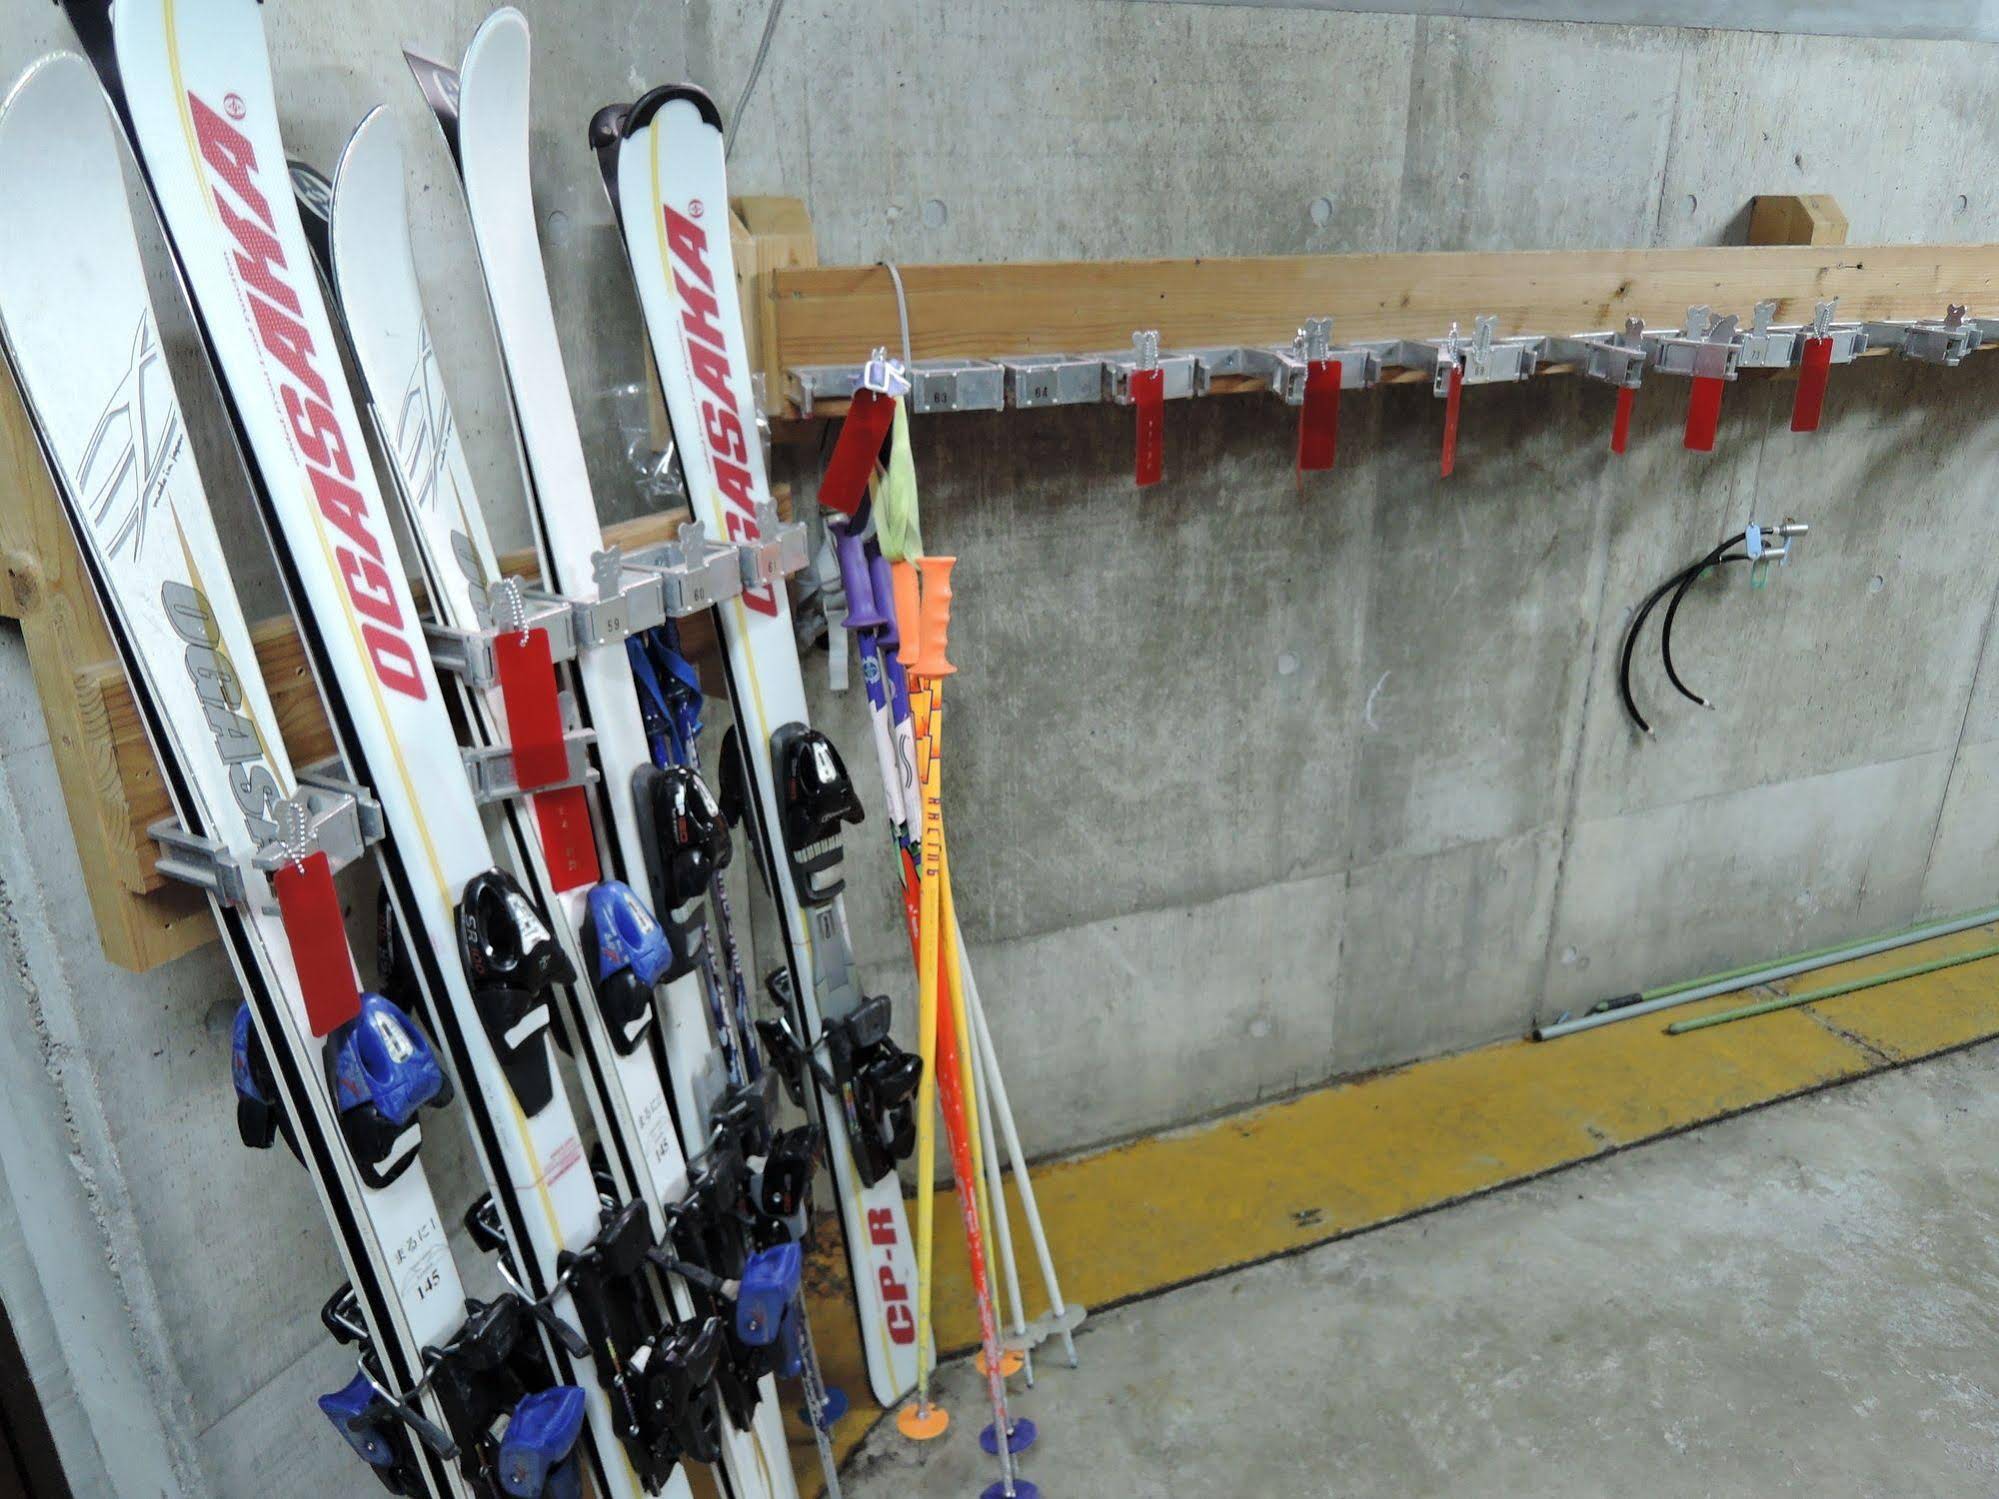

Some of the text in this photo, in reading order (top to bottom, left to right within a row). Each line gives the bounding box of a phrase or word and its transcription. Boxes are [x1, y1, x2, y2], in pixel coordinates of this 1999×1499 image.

[187, 89, 427, 702] OGASAKA
[607, 617, 620, 633] 59
[160, 579, 282, 855] OGAS
[465, 914, 478, 944] SR
[417, 1268, 440, 1300] 145
[868, 1207, 916, 1347] CP-R
